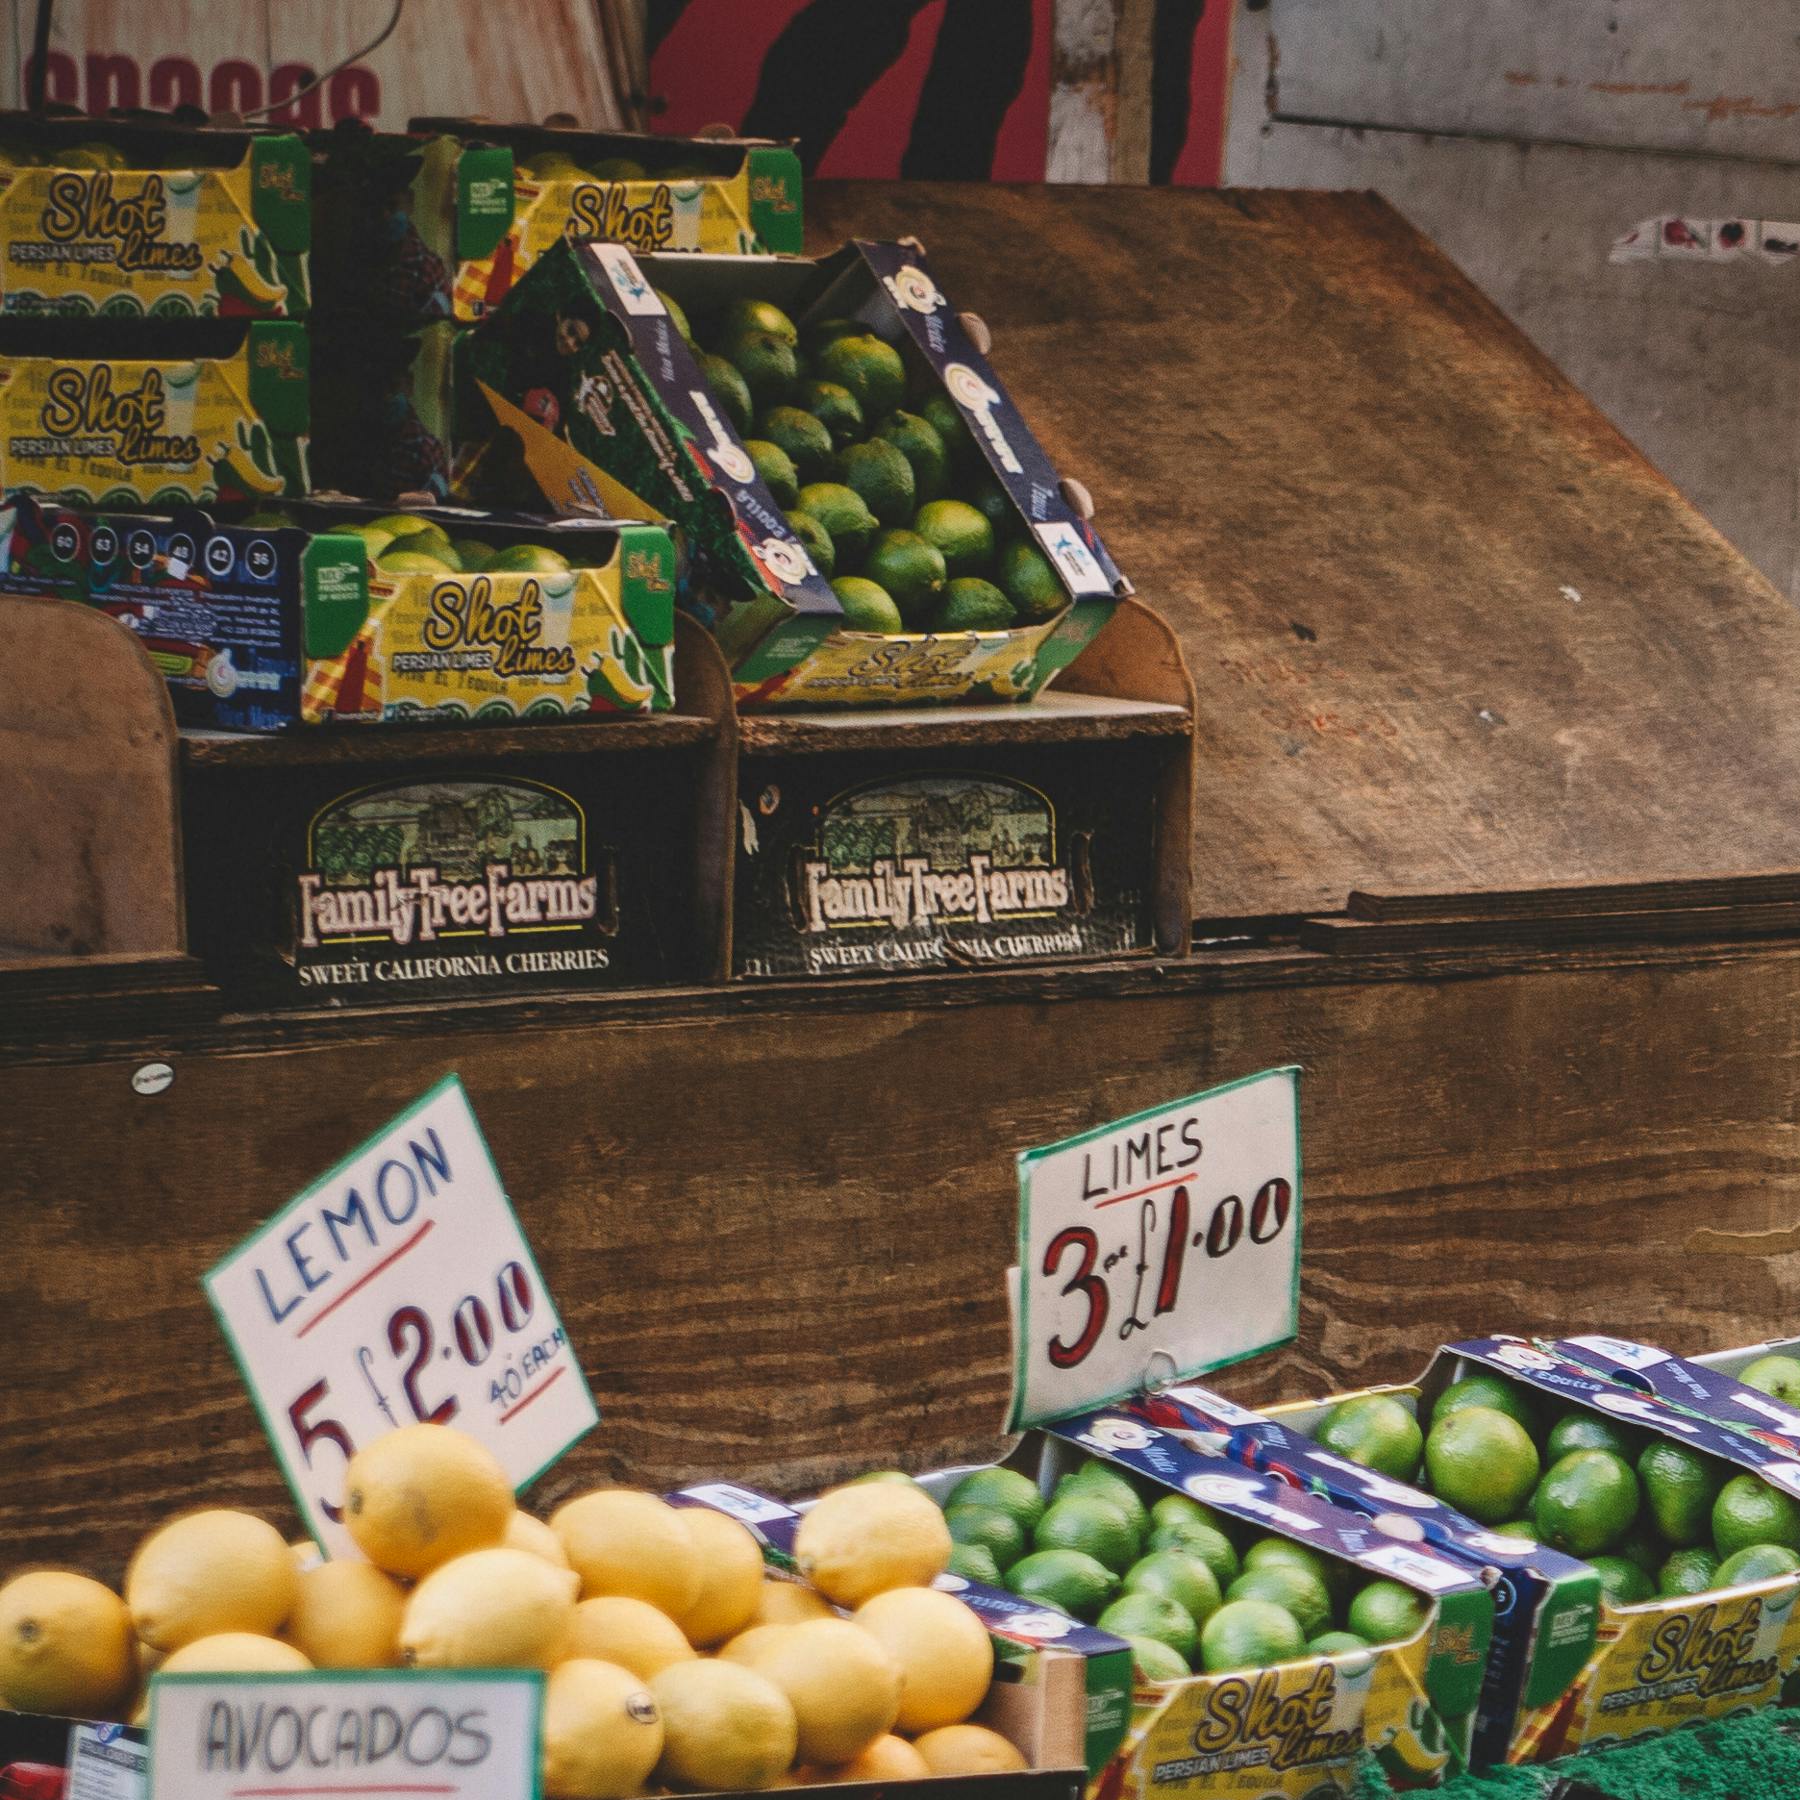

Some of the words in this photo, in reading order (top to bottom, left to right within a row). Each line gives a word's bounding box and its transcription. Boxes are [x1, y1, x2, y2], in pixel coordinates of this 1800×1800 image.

[41, 172, 166, 242] Shot
[565, 181, 674, 245] Shot
[9, 242, 74, 262] PERSIAN
[76, 242, 116, 262] LIMES
[41, 363, 166, 437] Shot
[9, 438, 73, 457] PERSIAN
[75, 438, 116, 457] LIMES
[423, 575, 542, 651] Shot
[392, 652, 450, 672] PERSIAN
[451, 651, 494, 670] LIMES
[298, 962, 370, 987] SWEET
[374, 954, 503, 982] CALIFORNIA
[505, 948, 610, 974] CHERRIES
[808, 945, 875, 970] SWEET
[1082, 1118, 1202, 1201] LIMES
[254, 1127, 452, 1324] LEMON
[1042, 1226, 1110, 1369] 3
[521, 1326, 565, 1379] EACH
[288, 1376, 356, 1526] 5
[1636, 1596, 1764, 1686] Shot
[1194, 1658, 1337, 1754] Shot
[1600, 1685, 1654, 1712] PERSIAN
[1653, 1677, 1700, 1700] LIMES
[204, 1700, 494, 1775] AVOCADOS
[1151, 1755, 1222, 1784] PERSIAN
[1222, 1748, 1272, 1772] LIMES
